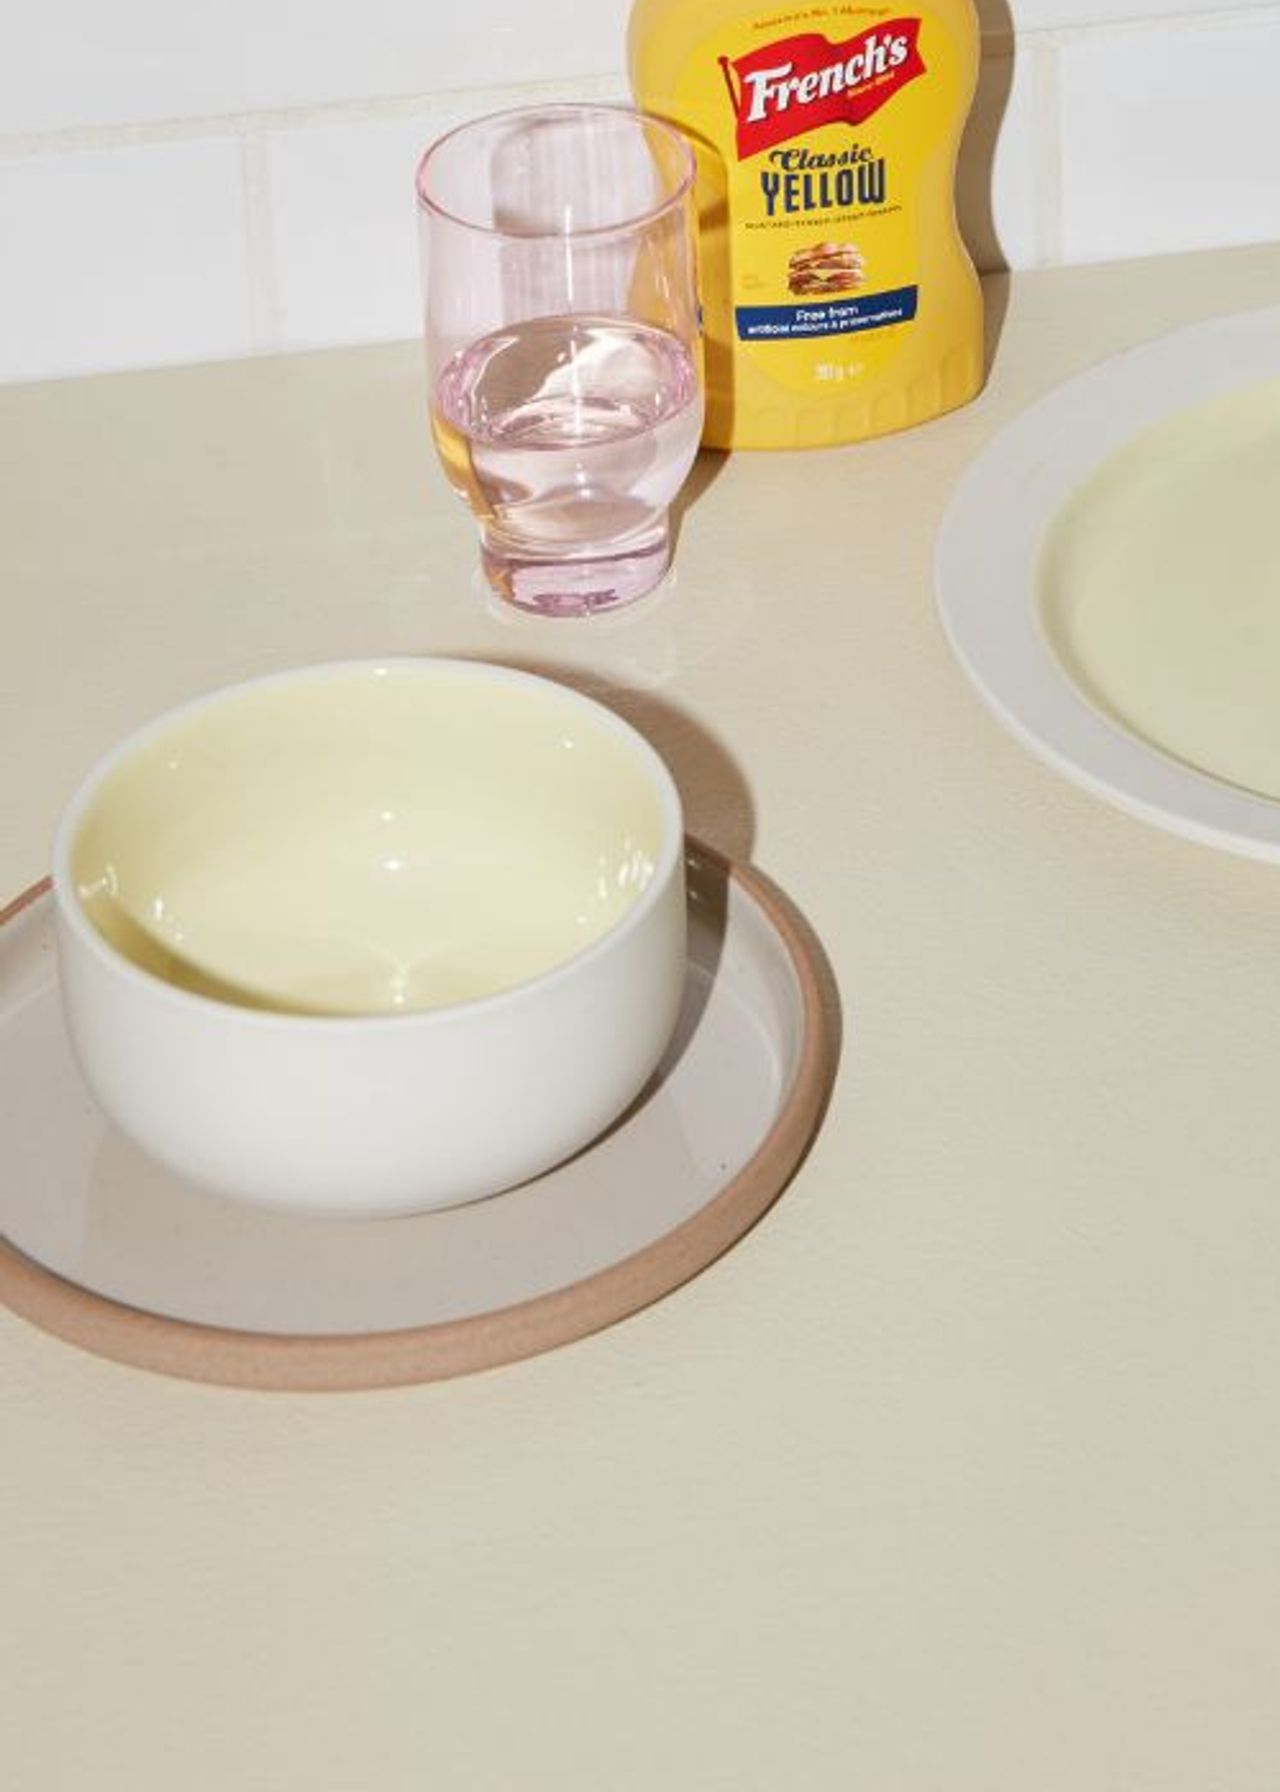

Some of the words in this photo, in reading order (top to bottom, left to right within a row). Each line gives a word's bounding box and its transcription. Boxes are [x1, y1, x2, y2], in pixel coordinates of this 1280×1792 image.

[743, 33, 909, 122] French's
[769, 143, 874, 171] Classic
[760, 158, 886, 217] YELLOW
[795, 309, 826, 322] Free
[829, 306, 859, 319] from
